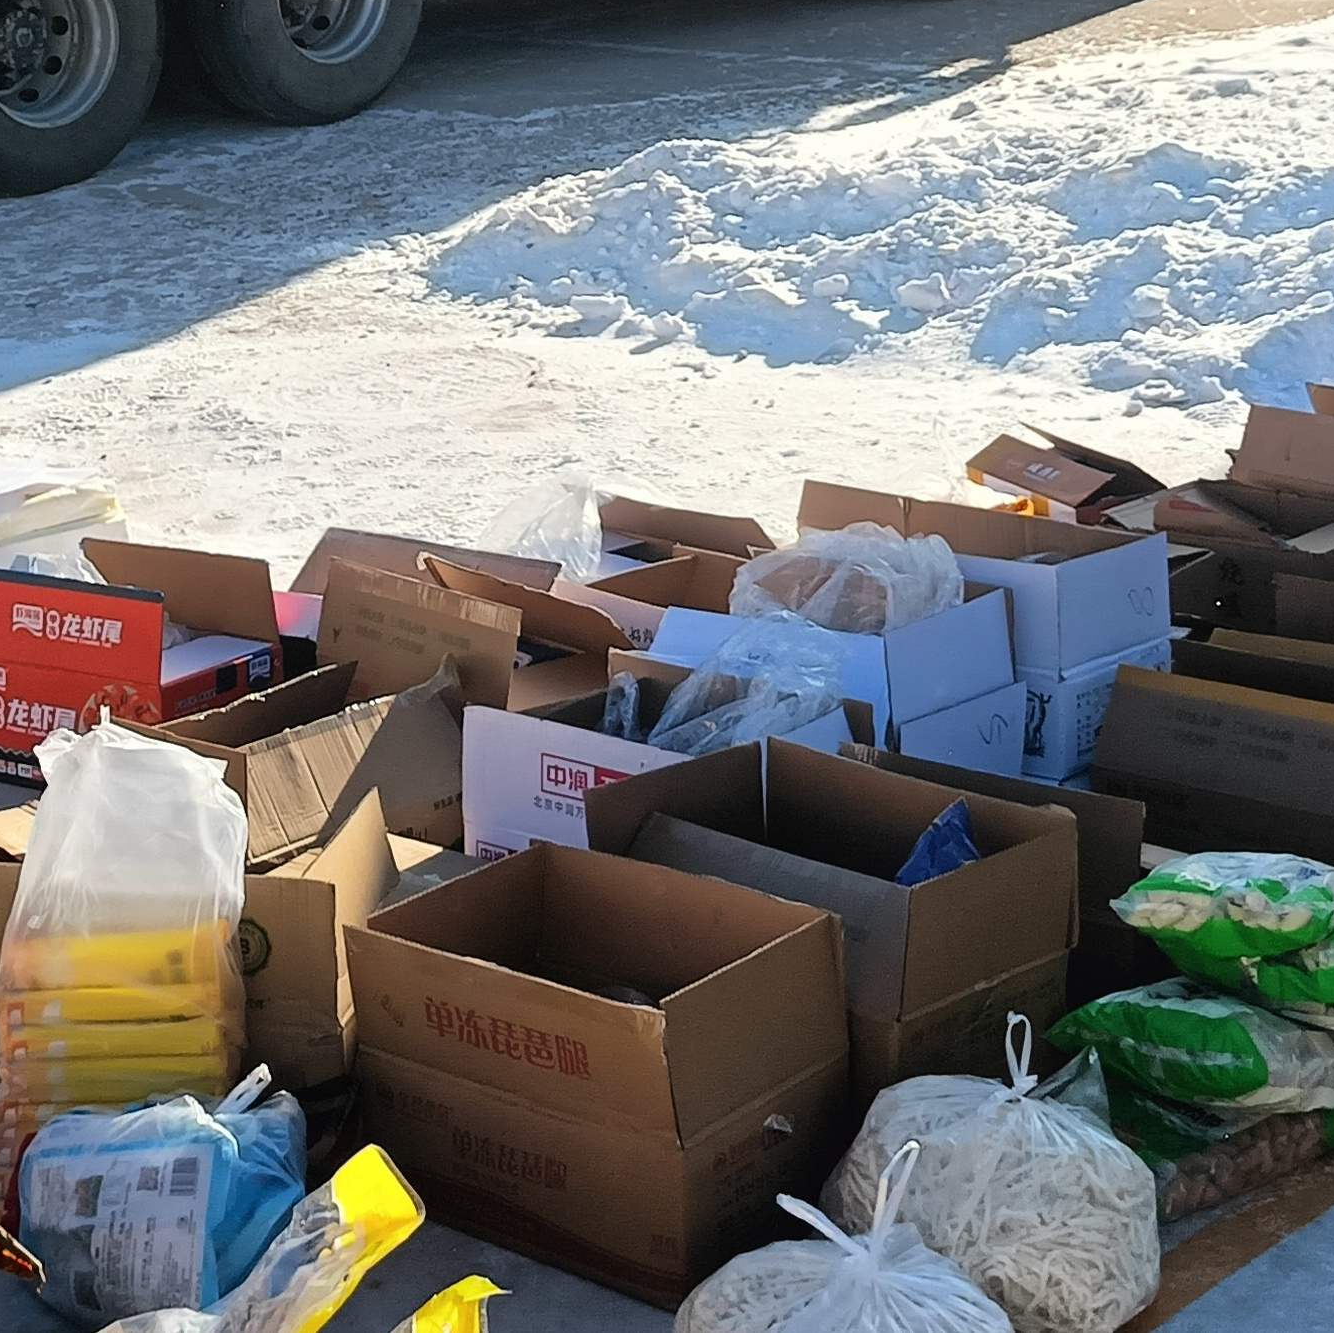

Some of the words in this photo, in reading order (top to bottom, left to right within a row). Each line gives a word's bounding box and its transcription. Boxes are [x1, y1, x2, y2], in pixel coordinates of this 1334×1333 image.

[546, 764, 588, 791] 中润
[424, 995, 592, 1081] 单冻琵琶腿
